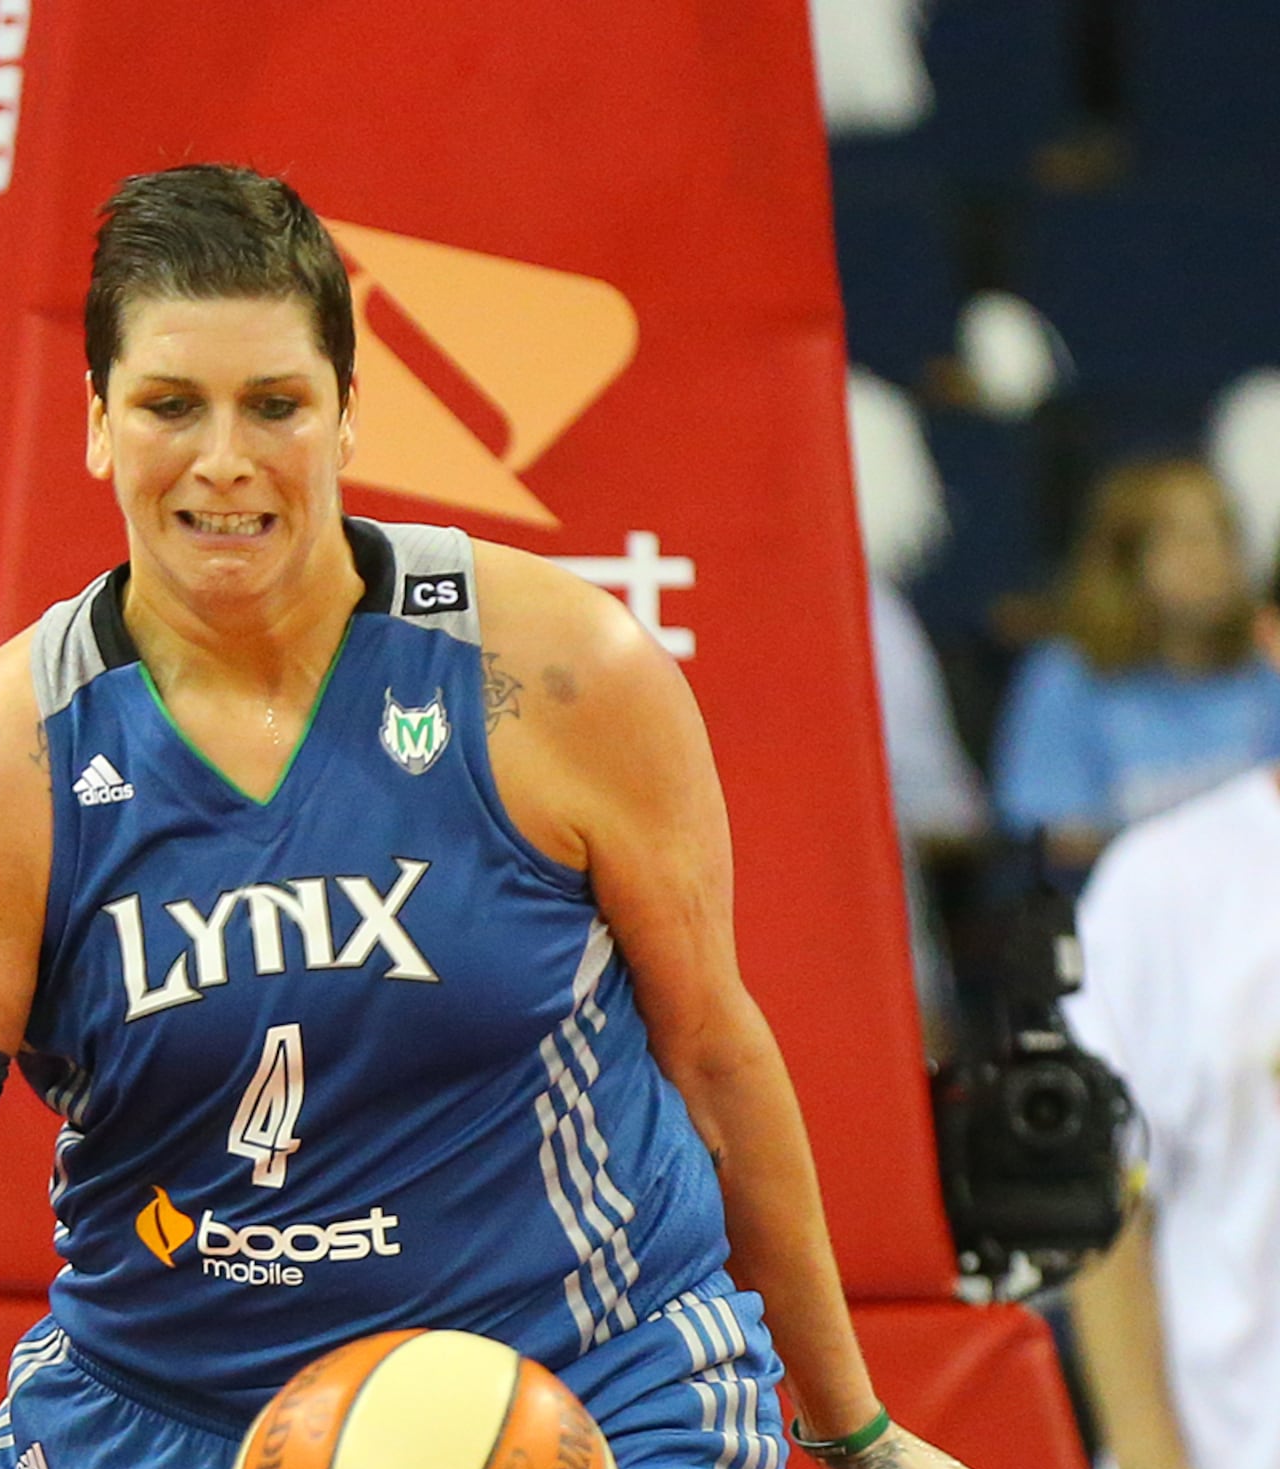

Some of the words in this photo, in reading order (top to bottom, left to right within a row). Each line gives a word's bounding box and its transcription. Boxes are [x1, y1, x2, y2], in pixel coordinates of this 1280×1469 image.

[413, 580, 459, 608] CS
[100, 856, 441, 1024] LYNX
[227, 1022, 306, 1189] 4
[197, 1207, 401, 1263] boost
[203, 1259, 304, 1287] mobile
